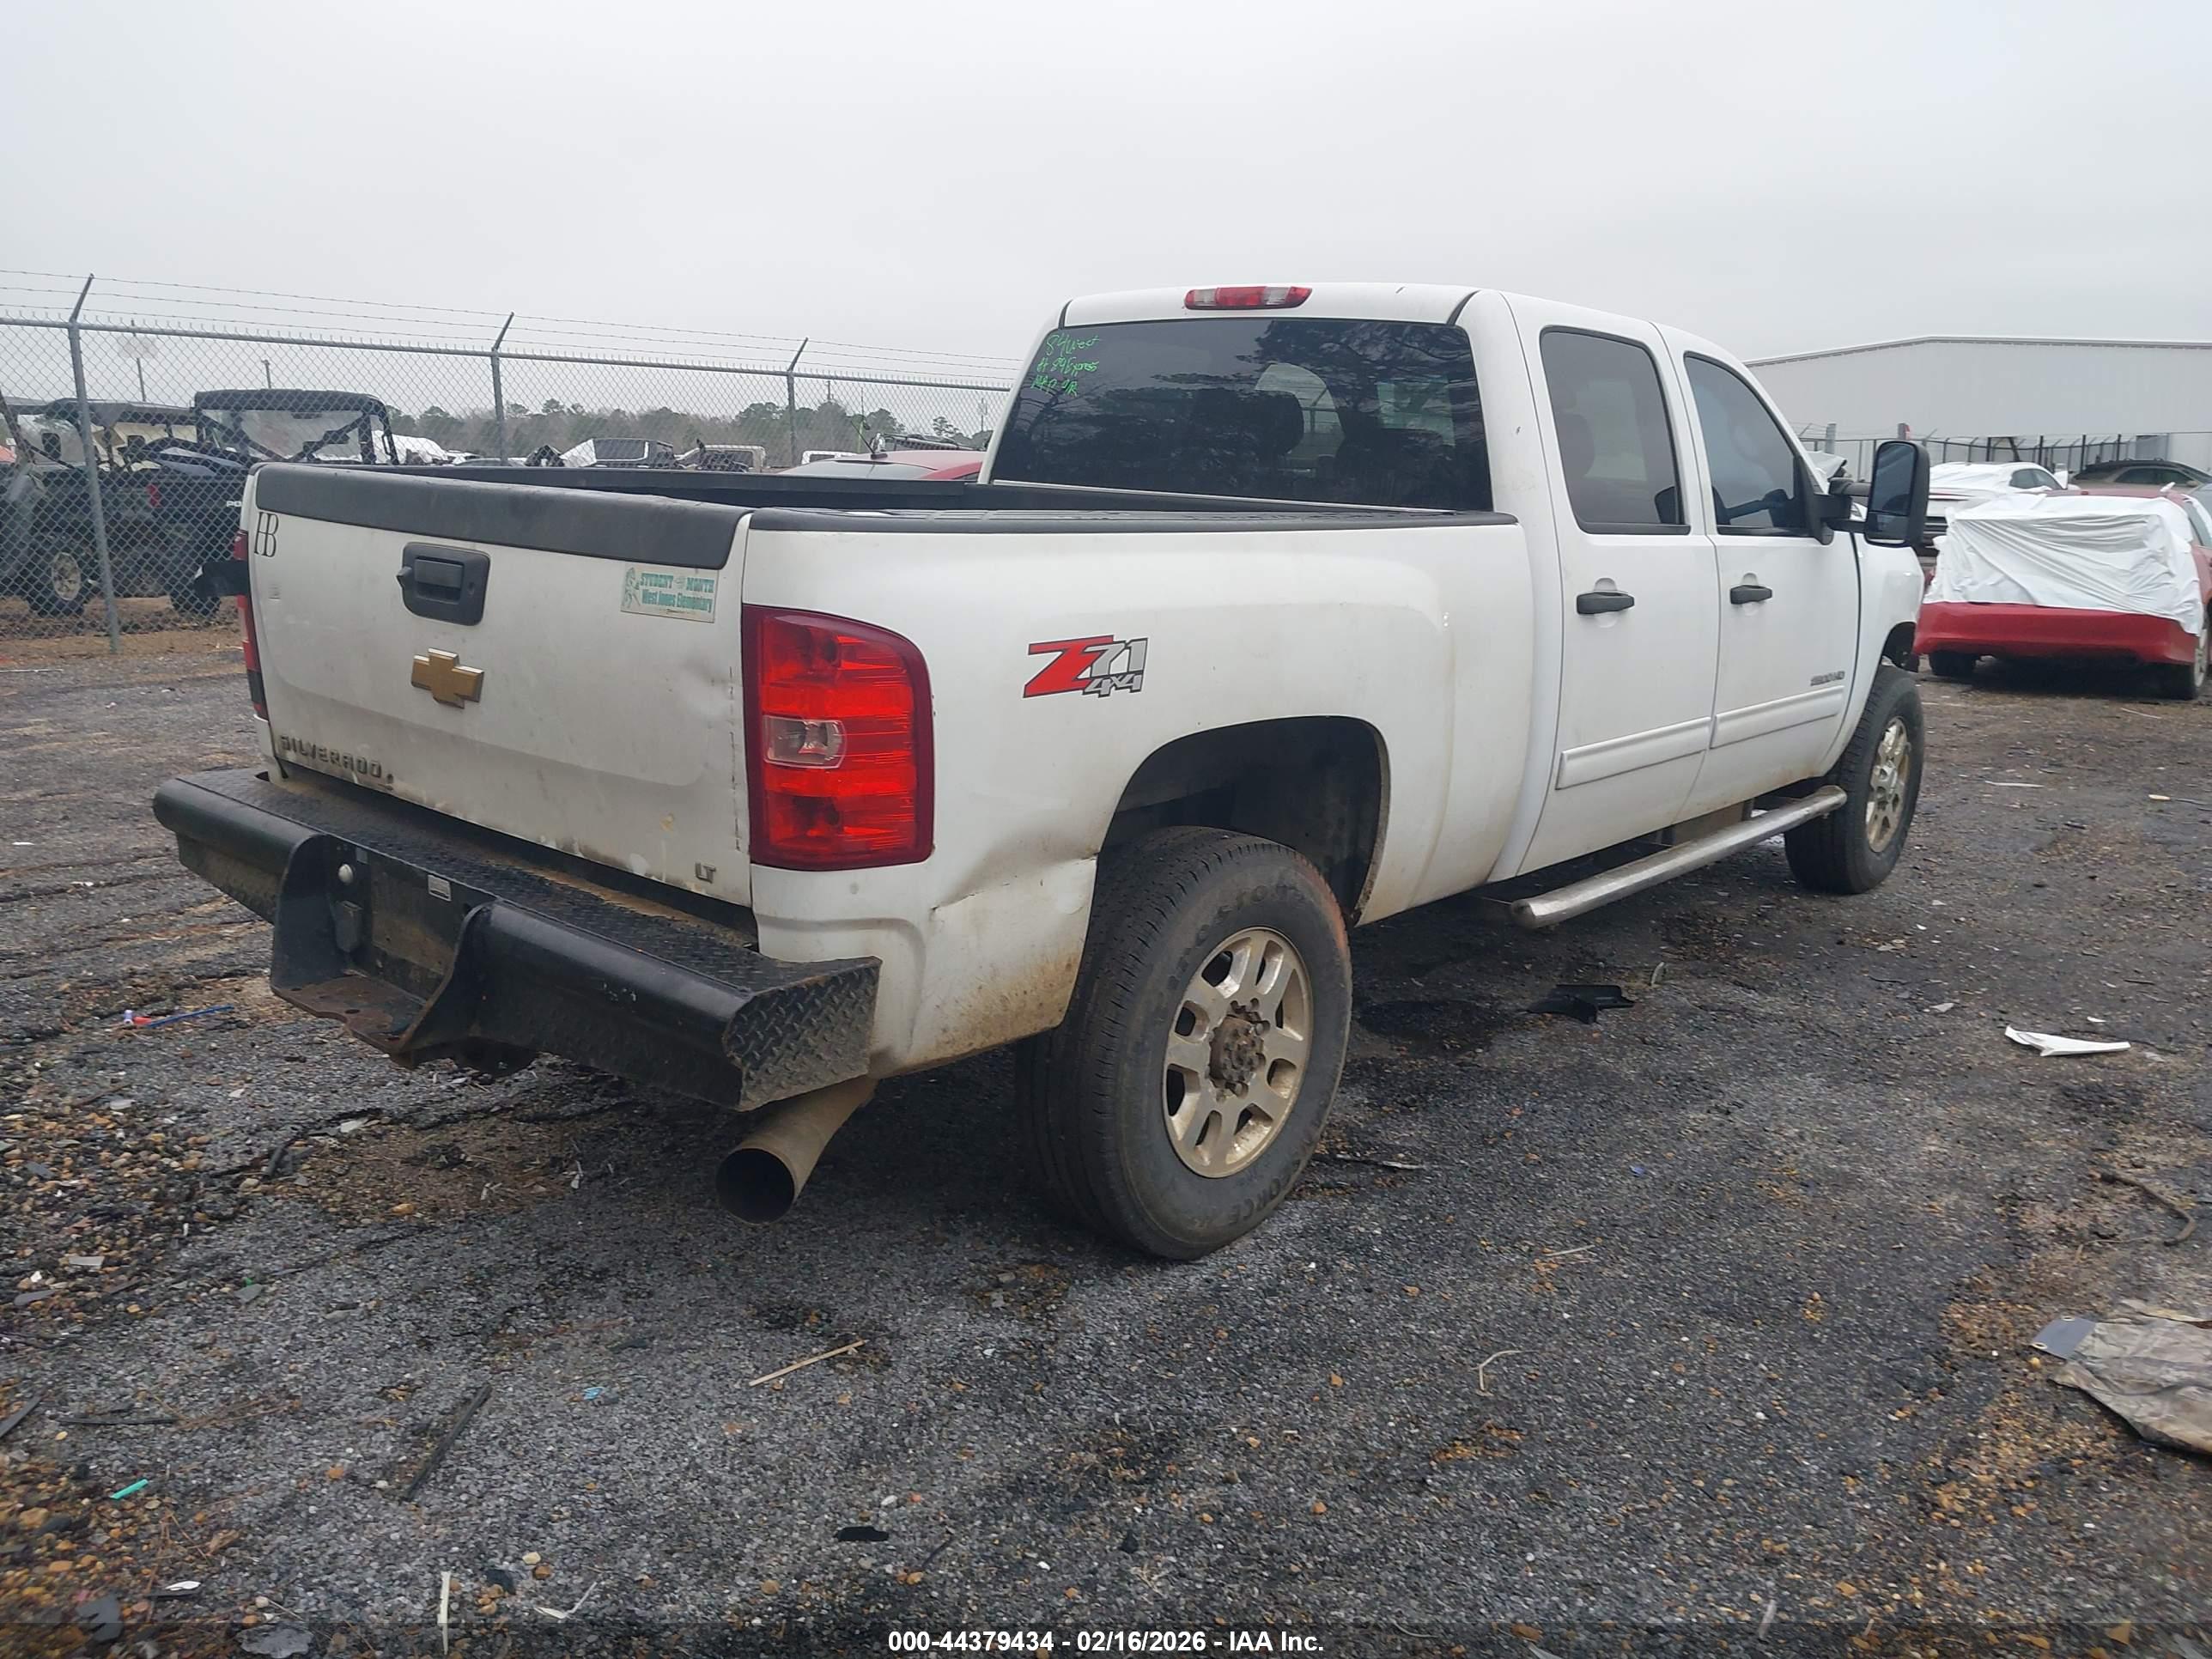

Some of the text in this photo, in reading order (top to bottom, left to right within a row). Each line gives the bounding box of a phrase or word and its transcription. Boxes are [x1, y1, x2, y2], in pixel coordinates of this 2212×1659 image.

[1022, 634, 1149, 698] Z71
[280, 735, 382, 779] SILVERADO
[694, 860, 717, 884] LT
